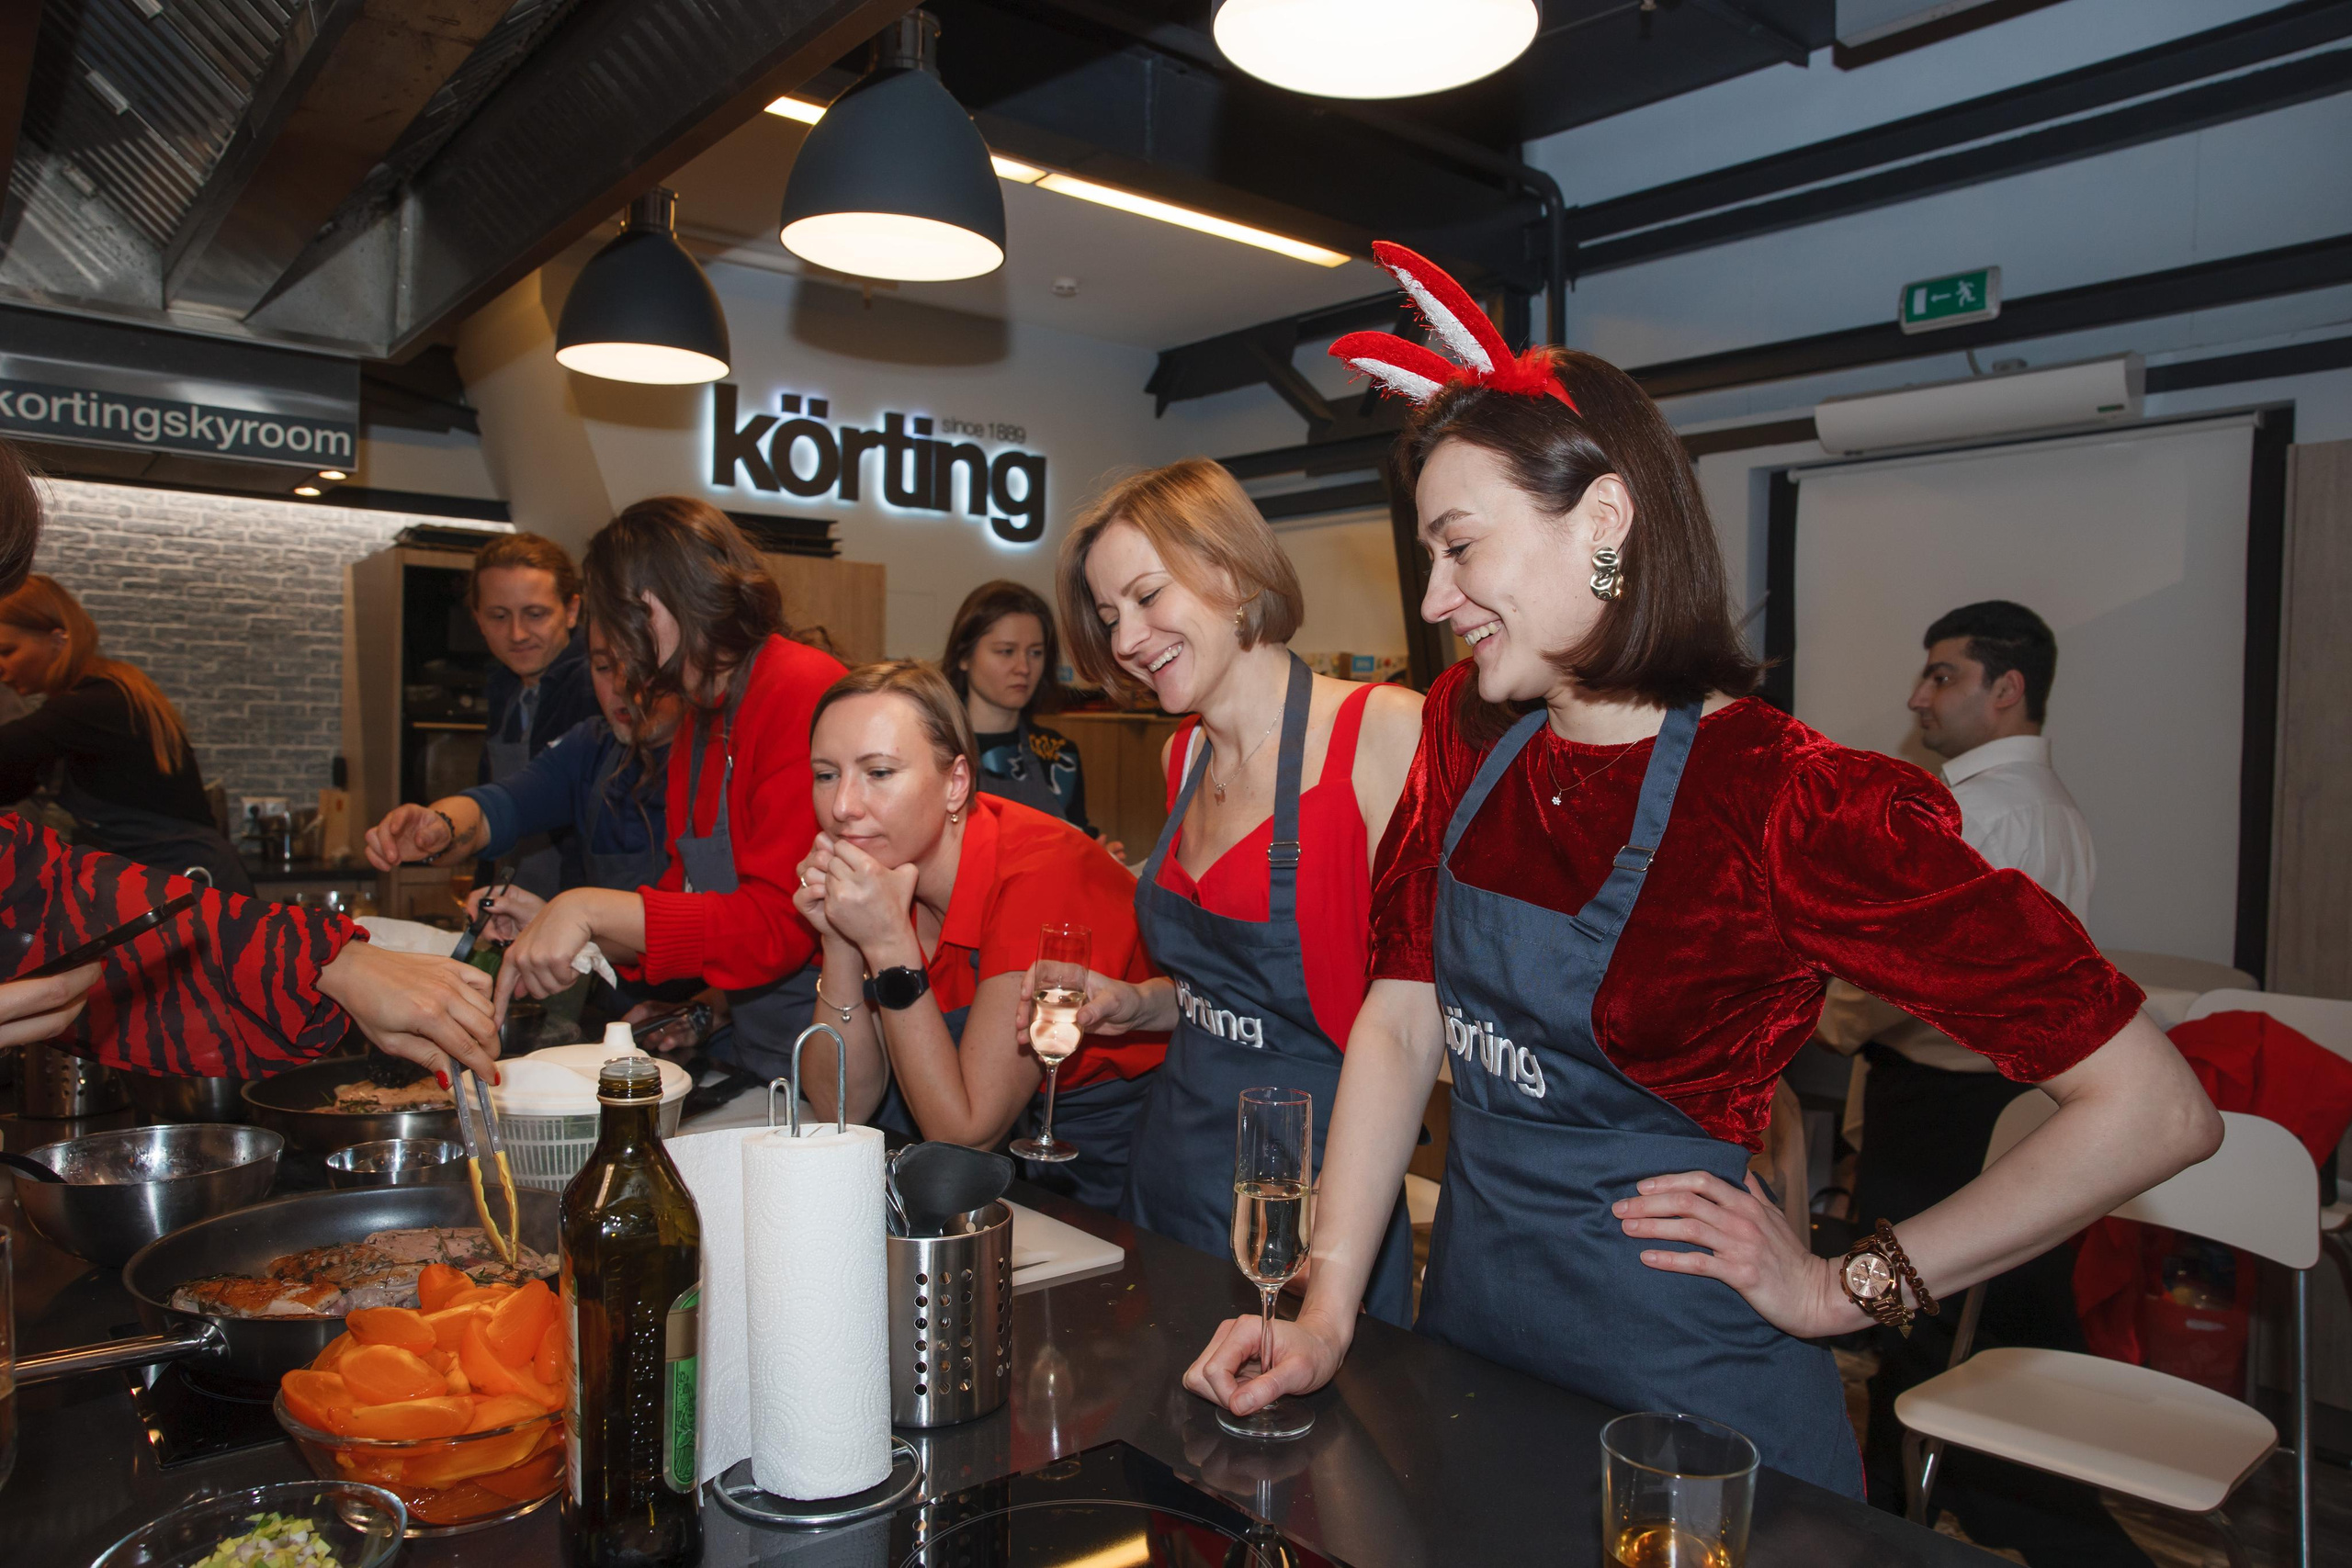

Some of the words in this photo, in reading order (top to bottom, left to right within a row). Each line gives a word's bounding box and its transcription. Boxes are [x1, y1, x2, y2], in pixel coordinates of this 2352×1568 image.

[712, 382, 1047, 543] körting
[942, 417, 985, 438] since
[989, 422, 1027, 445] 1889
